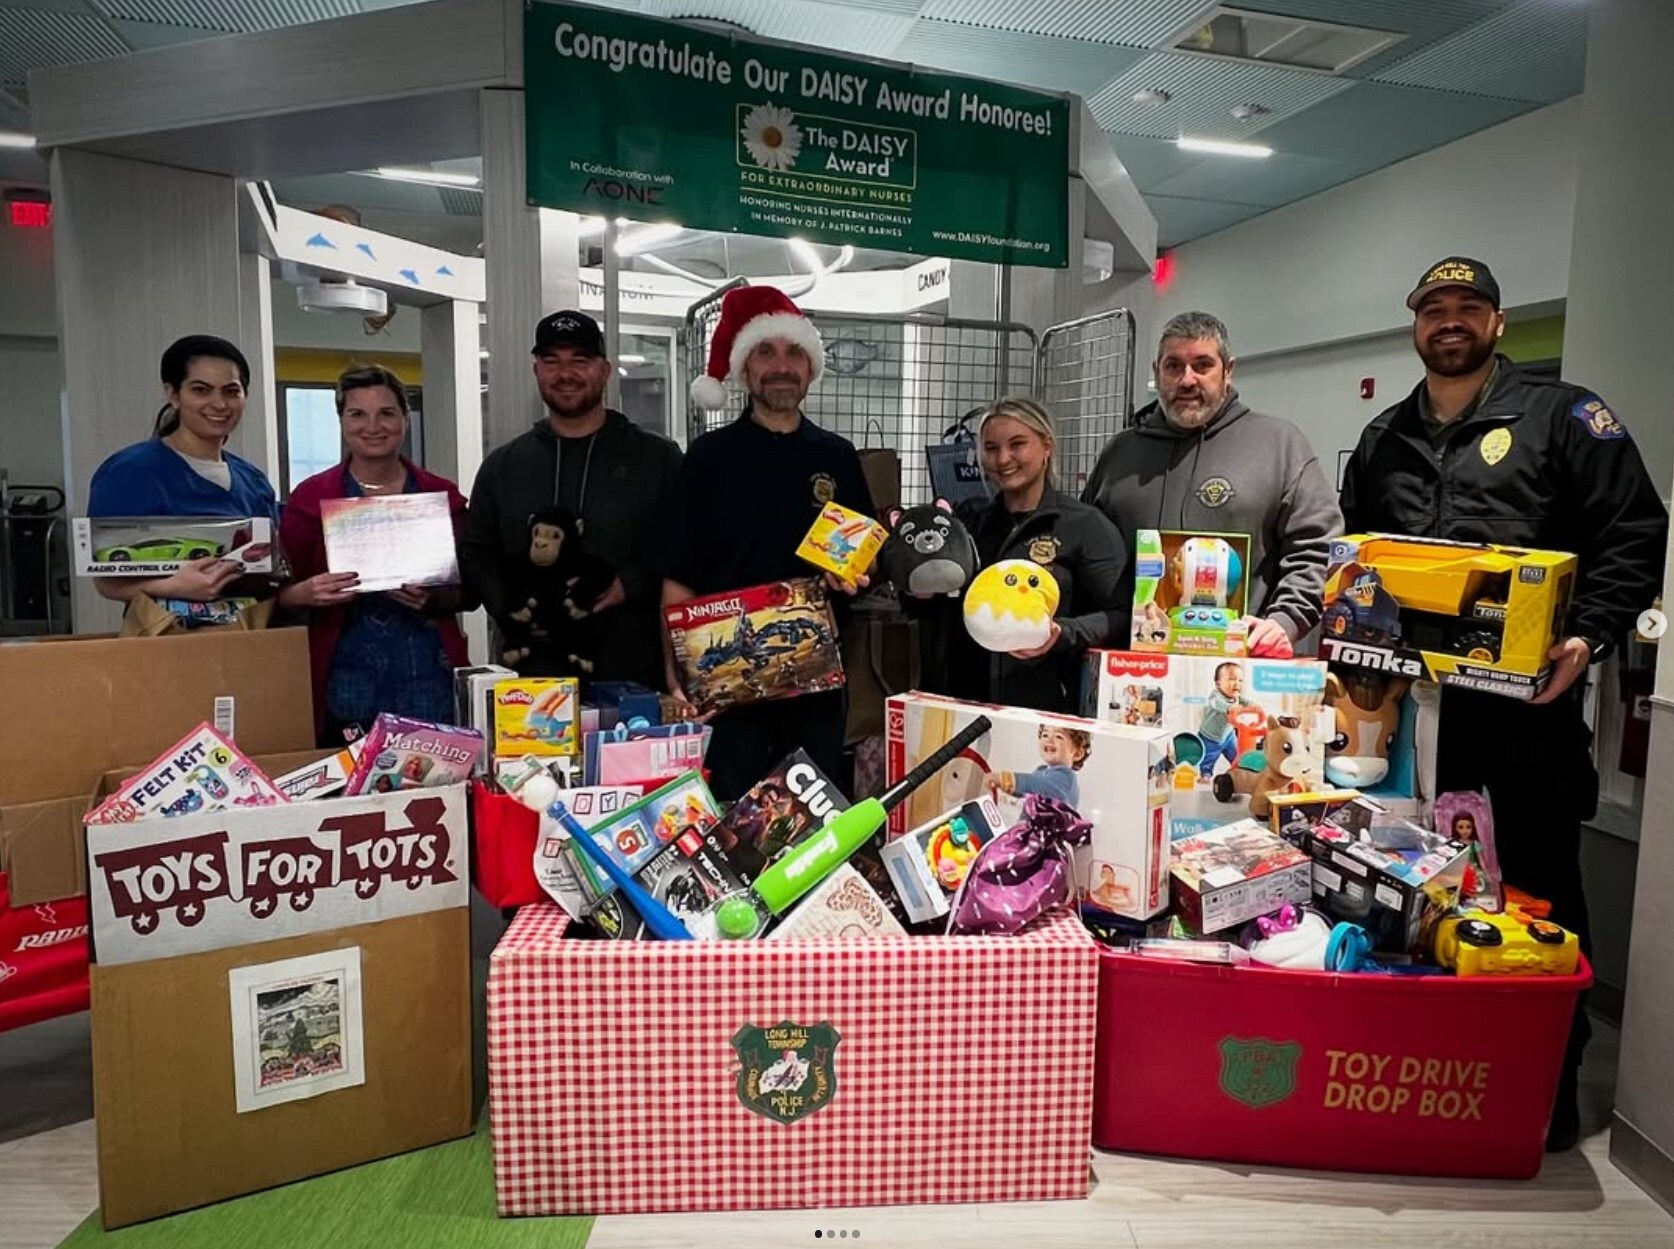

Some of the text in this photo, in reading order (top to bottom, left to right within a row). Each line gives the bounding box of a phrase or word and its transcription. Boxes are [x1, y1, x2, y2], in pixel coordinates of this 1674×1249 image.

[555, 22, 1052, 135] Congratulate Our DAISY Award Honoree!
[805, 127, 909, 158] The DAISY
[569, 160, 674, 185] In Collaboration with
[825, 151, 890, 178] Award
[741, 171, 912, 203] FOR EXTRAORDINARY NURSES
[739, 195, 913, 225] HONORING NURSES INTERNATIONALLY
[751, 211, 761, 220] IN
[763, 213, 802, 227] MEMORY
[805, 219, 817, 229] OF
[829, 222, 865, 234] PATRICK
[868, 226, 902, 237] BARNES
[932, 230, 1051, 252] www.DAISYfoundation.org
[917, 266, 947, 292] CANDY
[87, 563, 180, 573] RADIO CONTROL CAR
[686, 597, 743, 623] NINJAGO
[1476, 606, 1507, 618] Ton
[1321, 638, 1422, 677] Tonka
[1446, 674, 1530, 697] STEEL CLASSICS
[215, 751, 228, 765] 6
[381, 732, 471, 764] Matching
[130, 766, 177, 807] FELT
[112, 833, 437, 904] TOYS FOR TOTS
[764, 1028, 810, 1040] LONG HILL
[1325, 1050, 1491, 1089] TOY DRIVE
[771, 1096, 804, 1107] POLICE
[1323, 1081, 1485, 1120] DROP BOX
